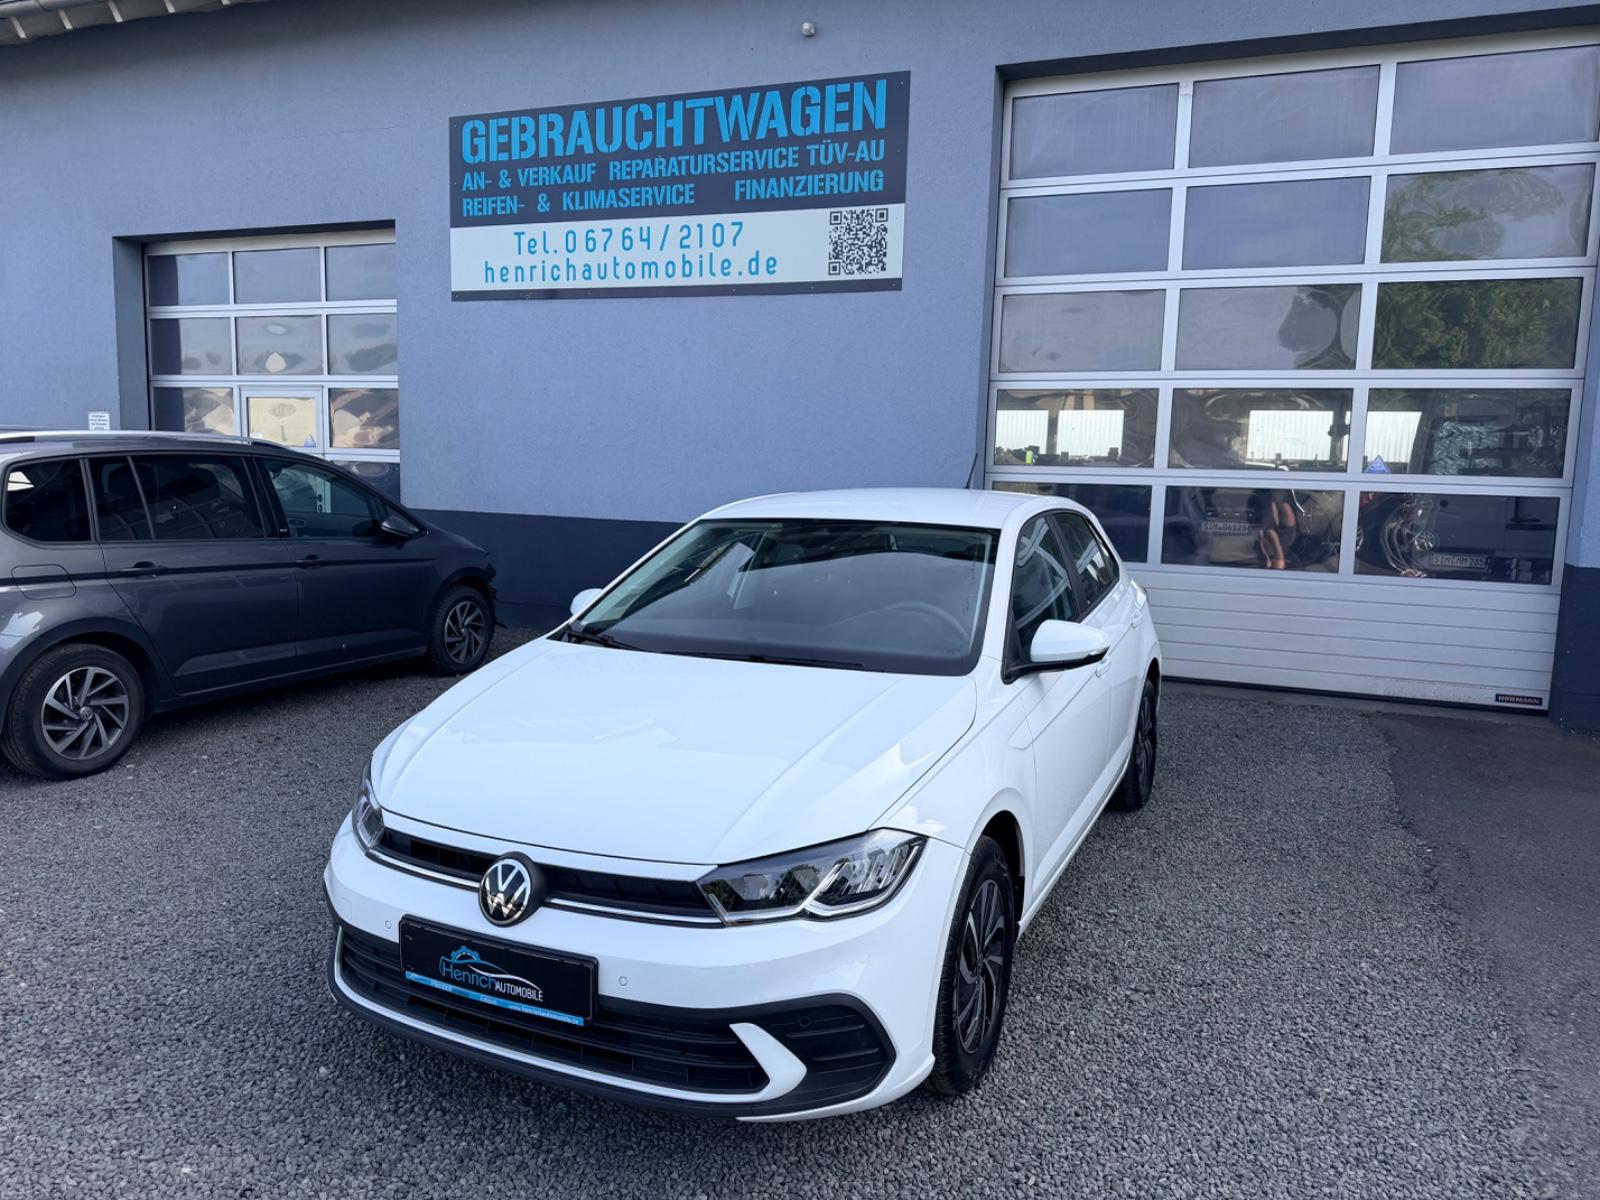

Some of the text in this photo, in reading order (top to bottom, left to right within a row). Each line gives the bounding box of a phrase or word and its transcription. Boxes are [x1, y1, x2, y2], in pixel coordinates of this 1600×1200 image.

[461, 79, 887, 164] GEBRAUCHTWAGEN
[462, 139, 885, 191] AN- & VERKAUF REPARATURSERVICE TÜV-AU
[462, 169, 884, 217] REIFEN- & KLIMASERVICE FINANZIERUNG
[484, 250, 778, 283] henrichautomobile.de
[442, 962, 496, 990] Henrich
